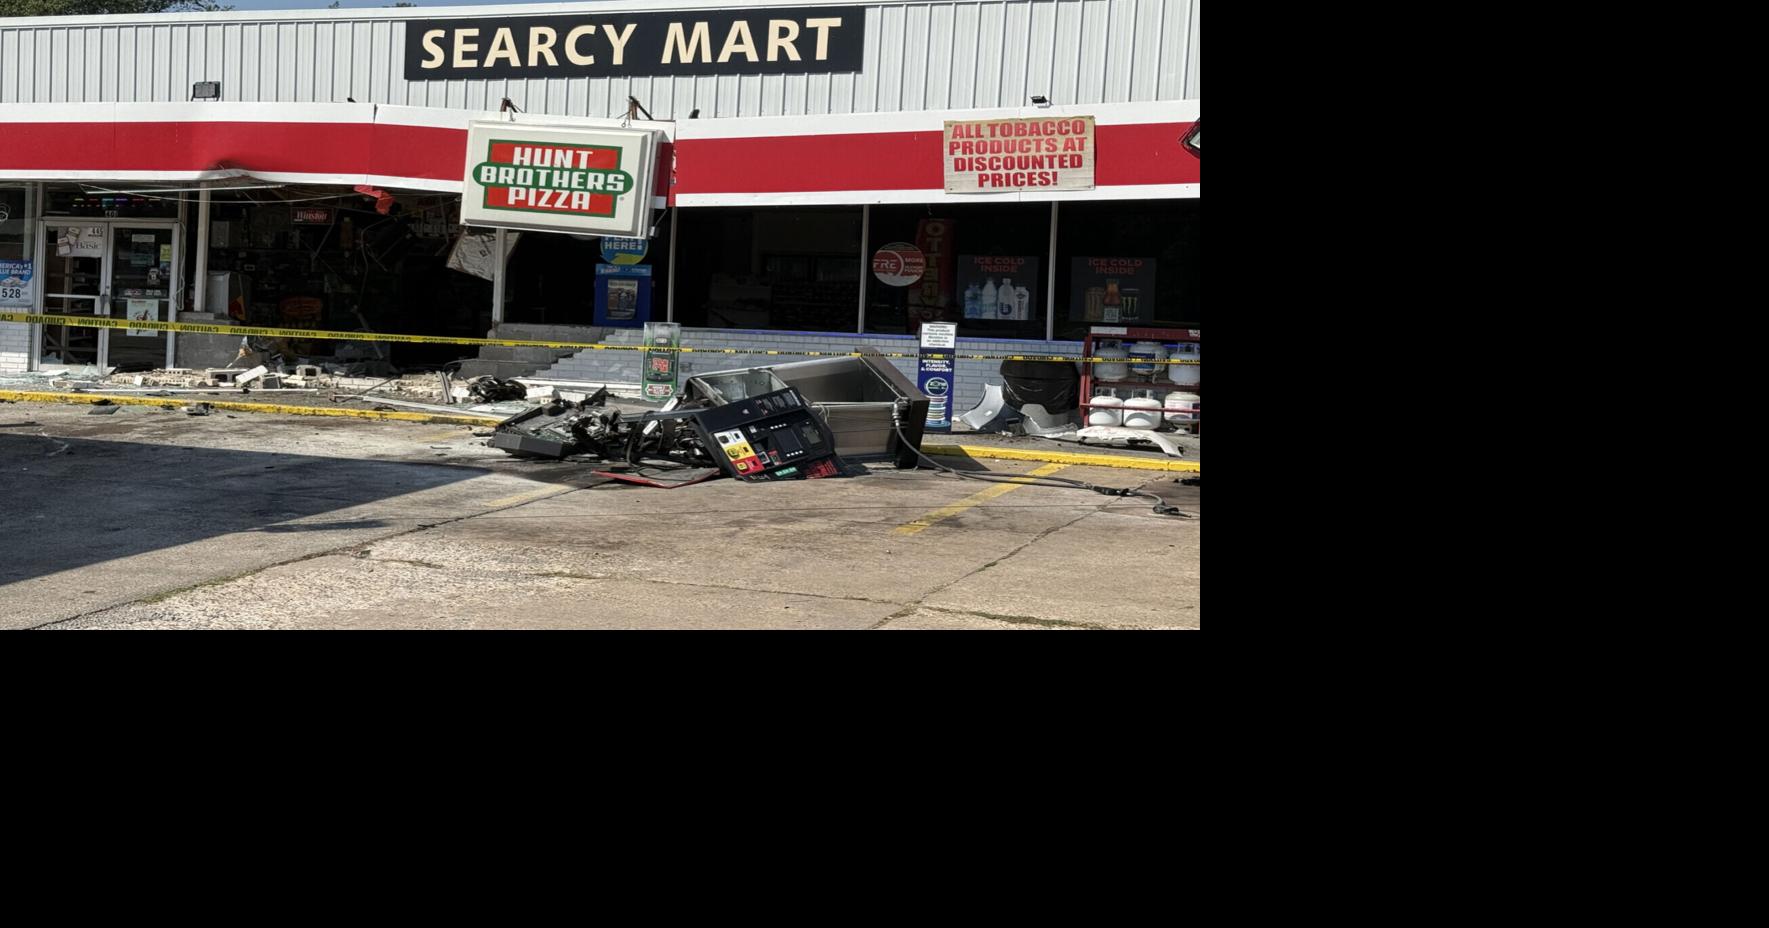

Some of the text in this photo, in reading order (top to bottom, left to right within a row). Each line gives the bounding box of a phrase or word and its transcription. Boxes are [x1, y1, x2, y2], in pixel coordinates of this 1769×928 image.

[420, 17, 842, 69] SEARCY MART
[951, 120, 1086, 140] ALL TOBACCO
[948, 137, 1088, 156] PRODUCTS AT
[512, 146, 593, 170] HUNT
[953, 154, 1083, 172] DISCOUNTED
[480, 165, 625, 192] BROTHERS
[977, 171, 1058, 188] PRICES!
[507, 188, 590, 210] PIZZA
[604, 241, 643, 250] HERE!
[974, 256, 1025, 265] ICE COLD
[980, 264, 1018, 273] INSIDE
[1088, 257, 1143, 266] ICE COLD
[1095, 266, 1136, 274] INSIDE
[2, 288, 21, 298] 528
